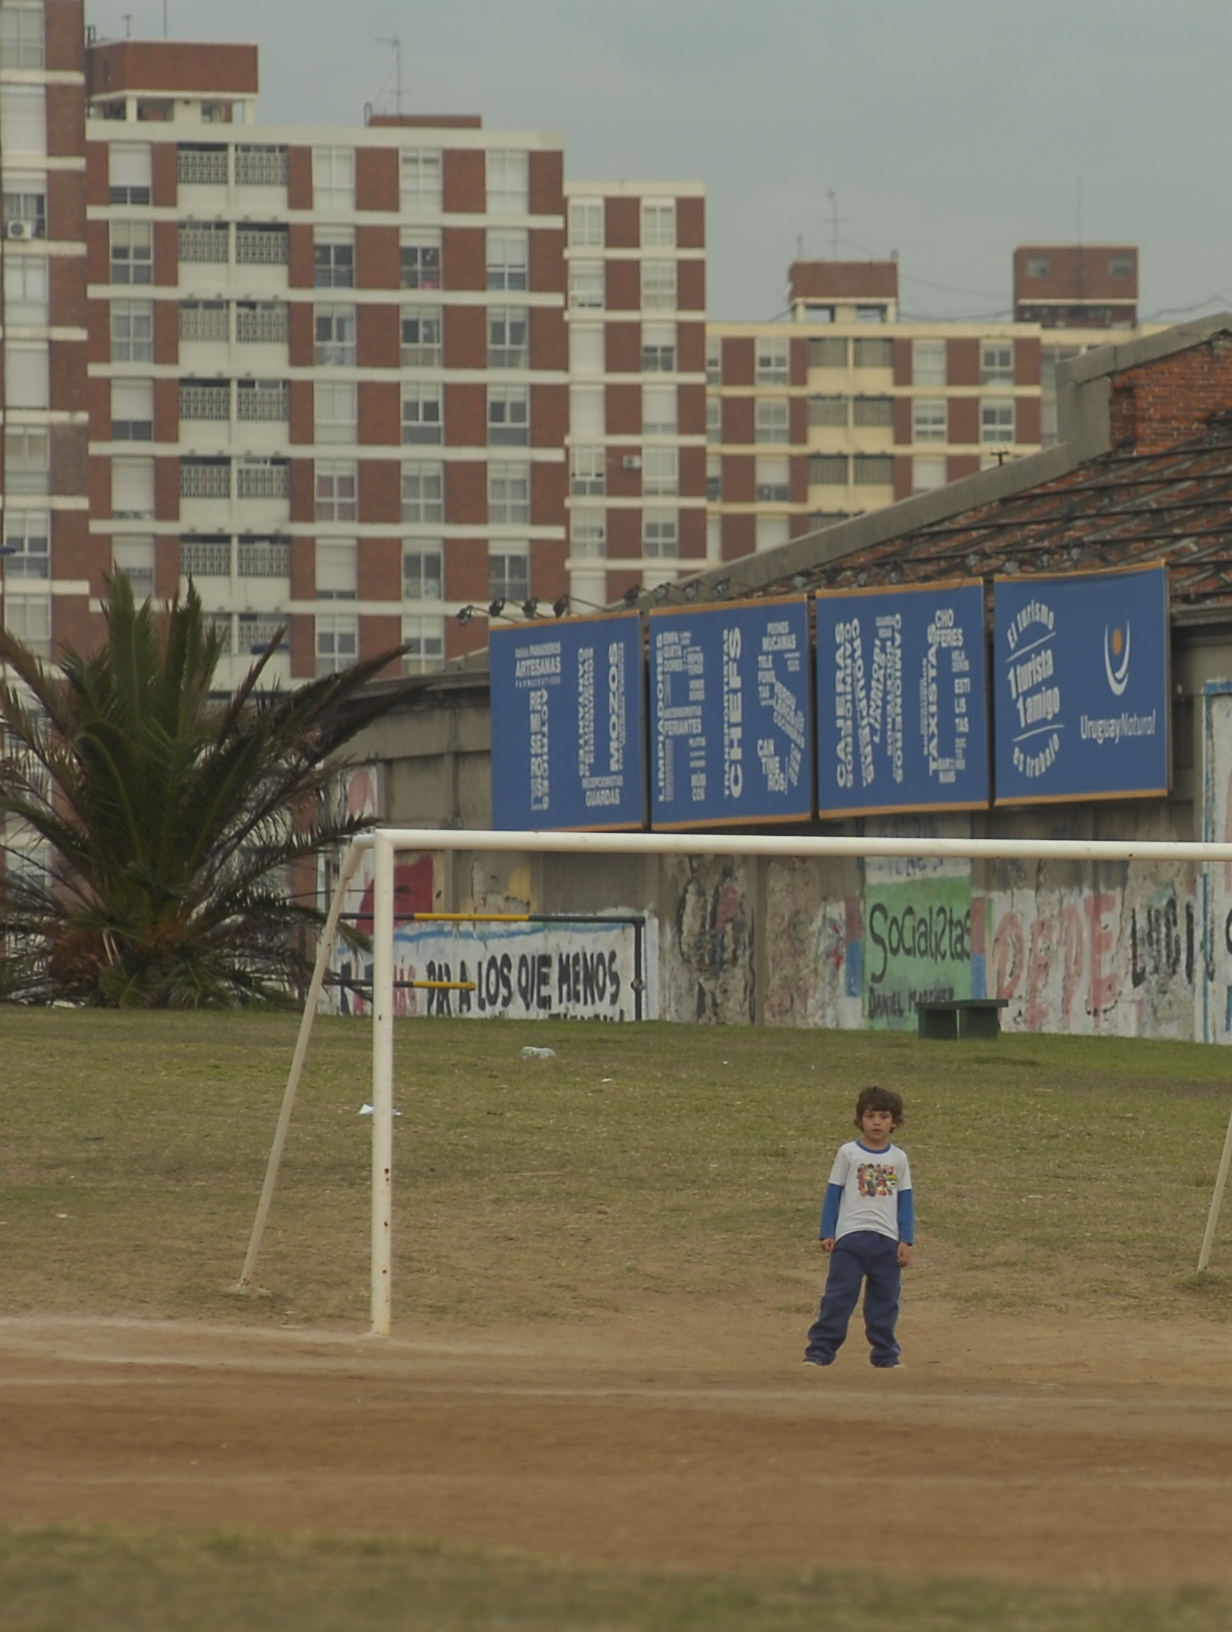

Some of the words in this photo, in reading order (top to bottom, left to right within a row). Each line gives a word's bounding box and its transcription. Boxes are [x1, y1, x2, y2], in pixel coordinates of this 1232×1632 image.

[1017, 599, 1055, 632] turismo
[515, 655, 562, 680] ARTESANAS
[1007, 666, 1017, 699] 1
[1016, 648, 1055, 694] turista
[609, 642, 619, 772] MOZOS
[728, 627, 743, 798] CHEFS
[835, 622, 846, 787] CAJERAS
[928, 623, 938, 776] TAXISTAS
[1016, 694, 1026, 728] 1
[1024, 685, 1061, 724] amigo
[1013, 744, 1025, 773] es
[1026, 731, 1061, 778] trabajo
[477, 953, 513, 1011] LOS
[517, 953, 553, 1011] QUE
[558, 950, 621, 1006] MENOS
